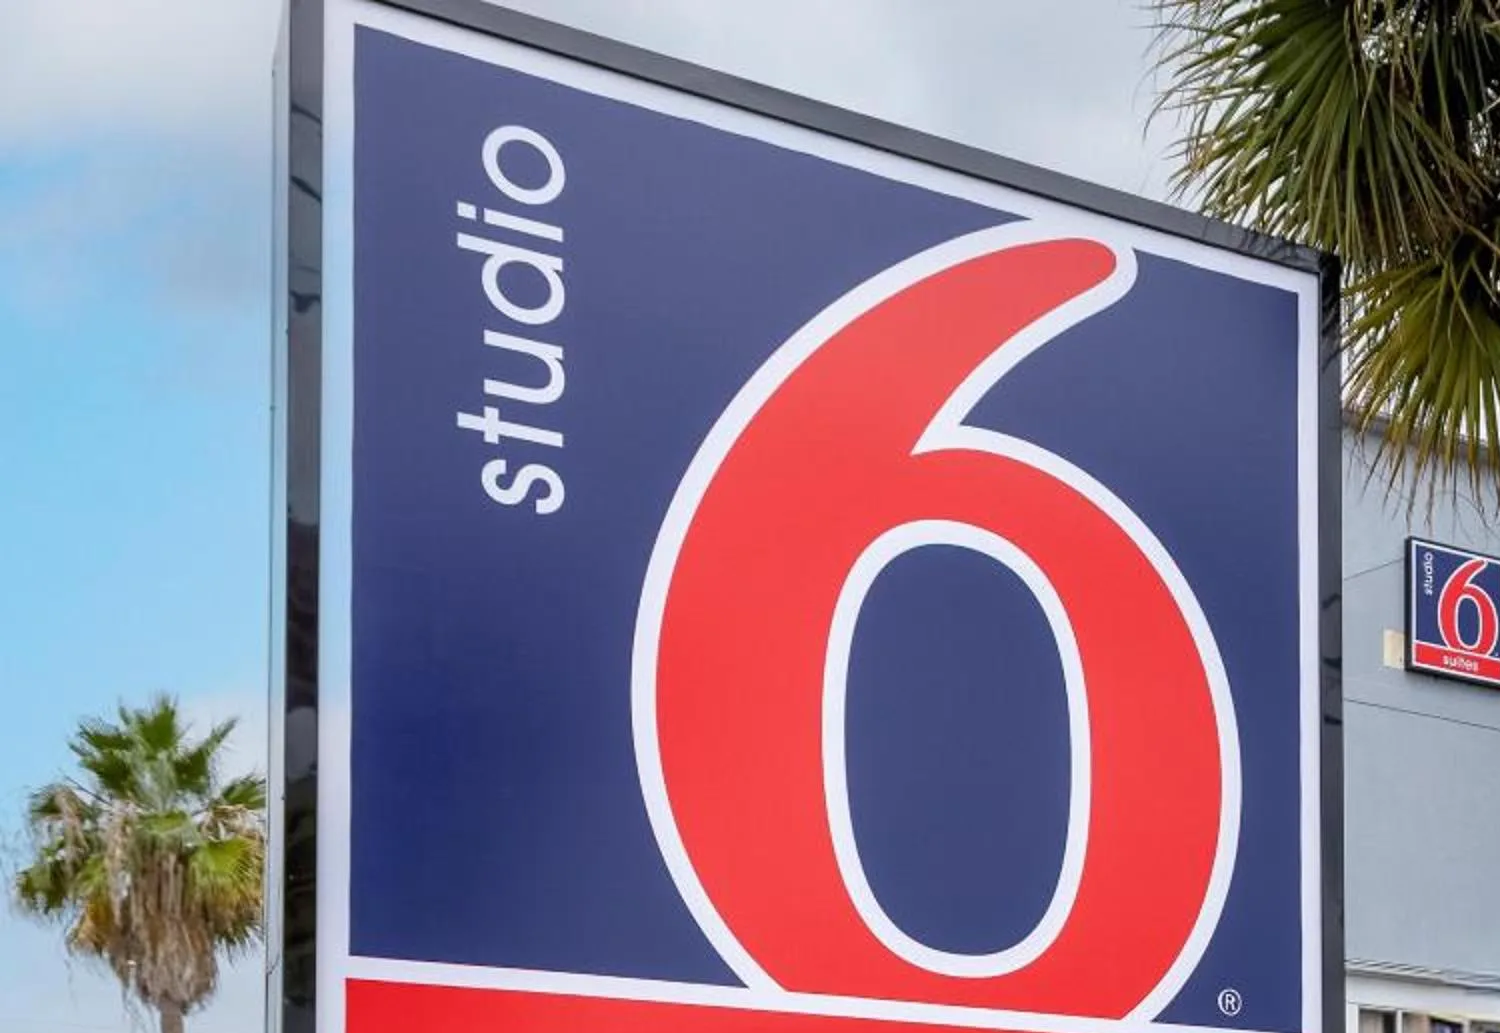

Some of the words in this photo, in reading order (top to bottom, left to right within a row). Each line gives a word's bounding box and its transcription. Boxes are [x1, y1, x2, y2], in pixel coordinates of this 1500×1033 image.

[457, 125, 566, 515] studio
[631, 219, 1242, 1022] 6
[1423, 552, 1434, 596] studio
[1438, 558, 1499, 657] 6
[1443, 655, 1479, 672] suites
